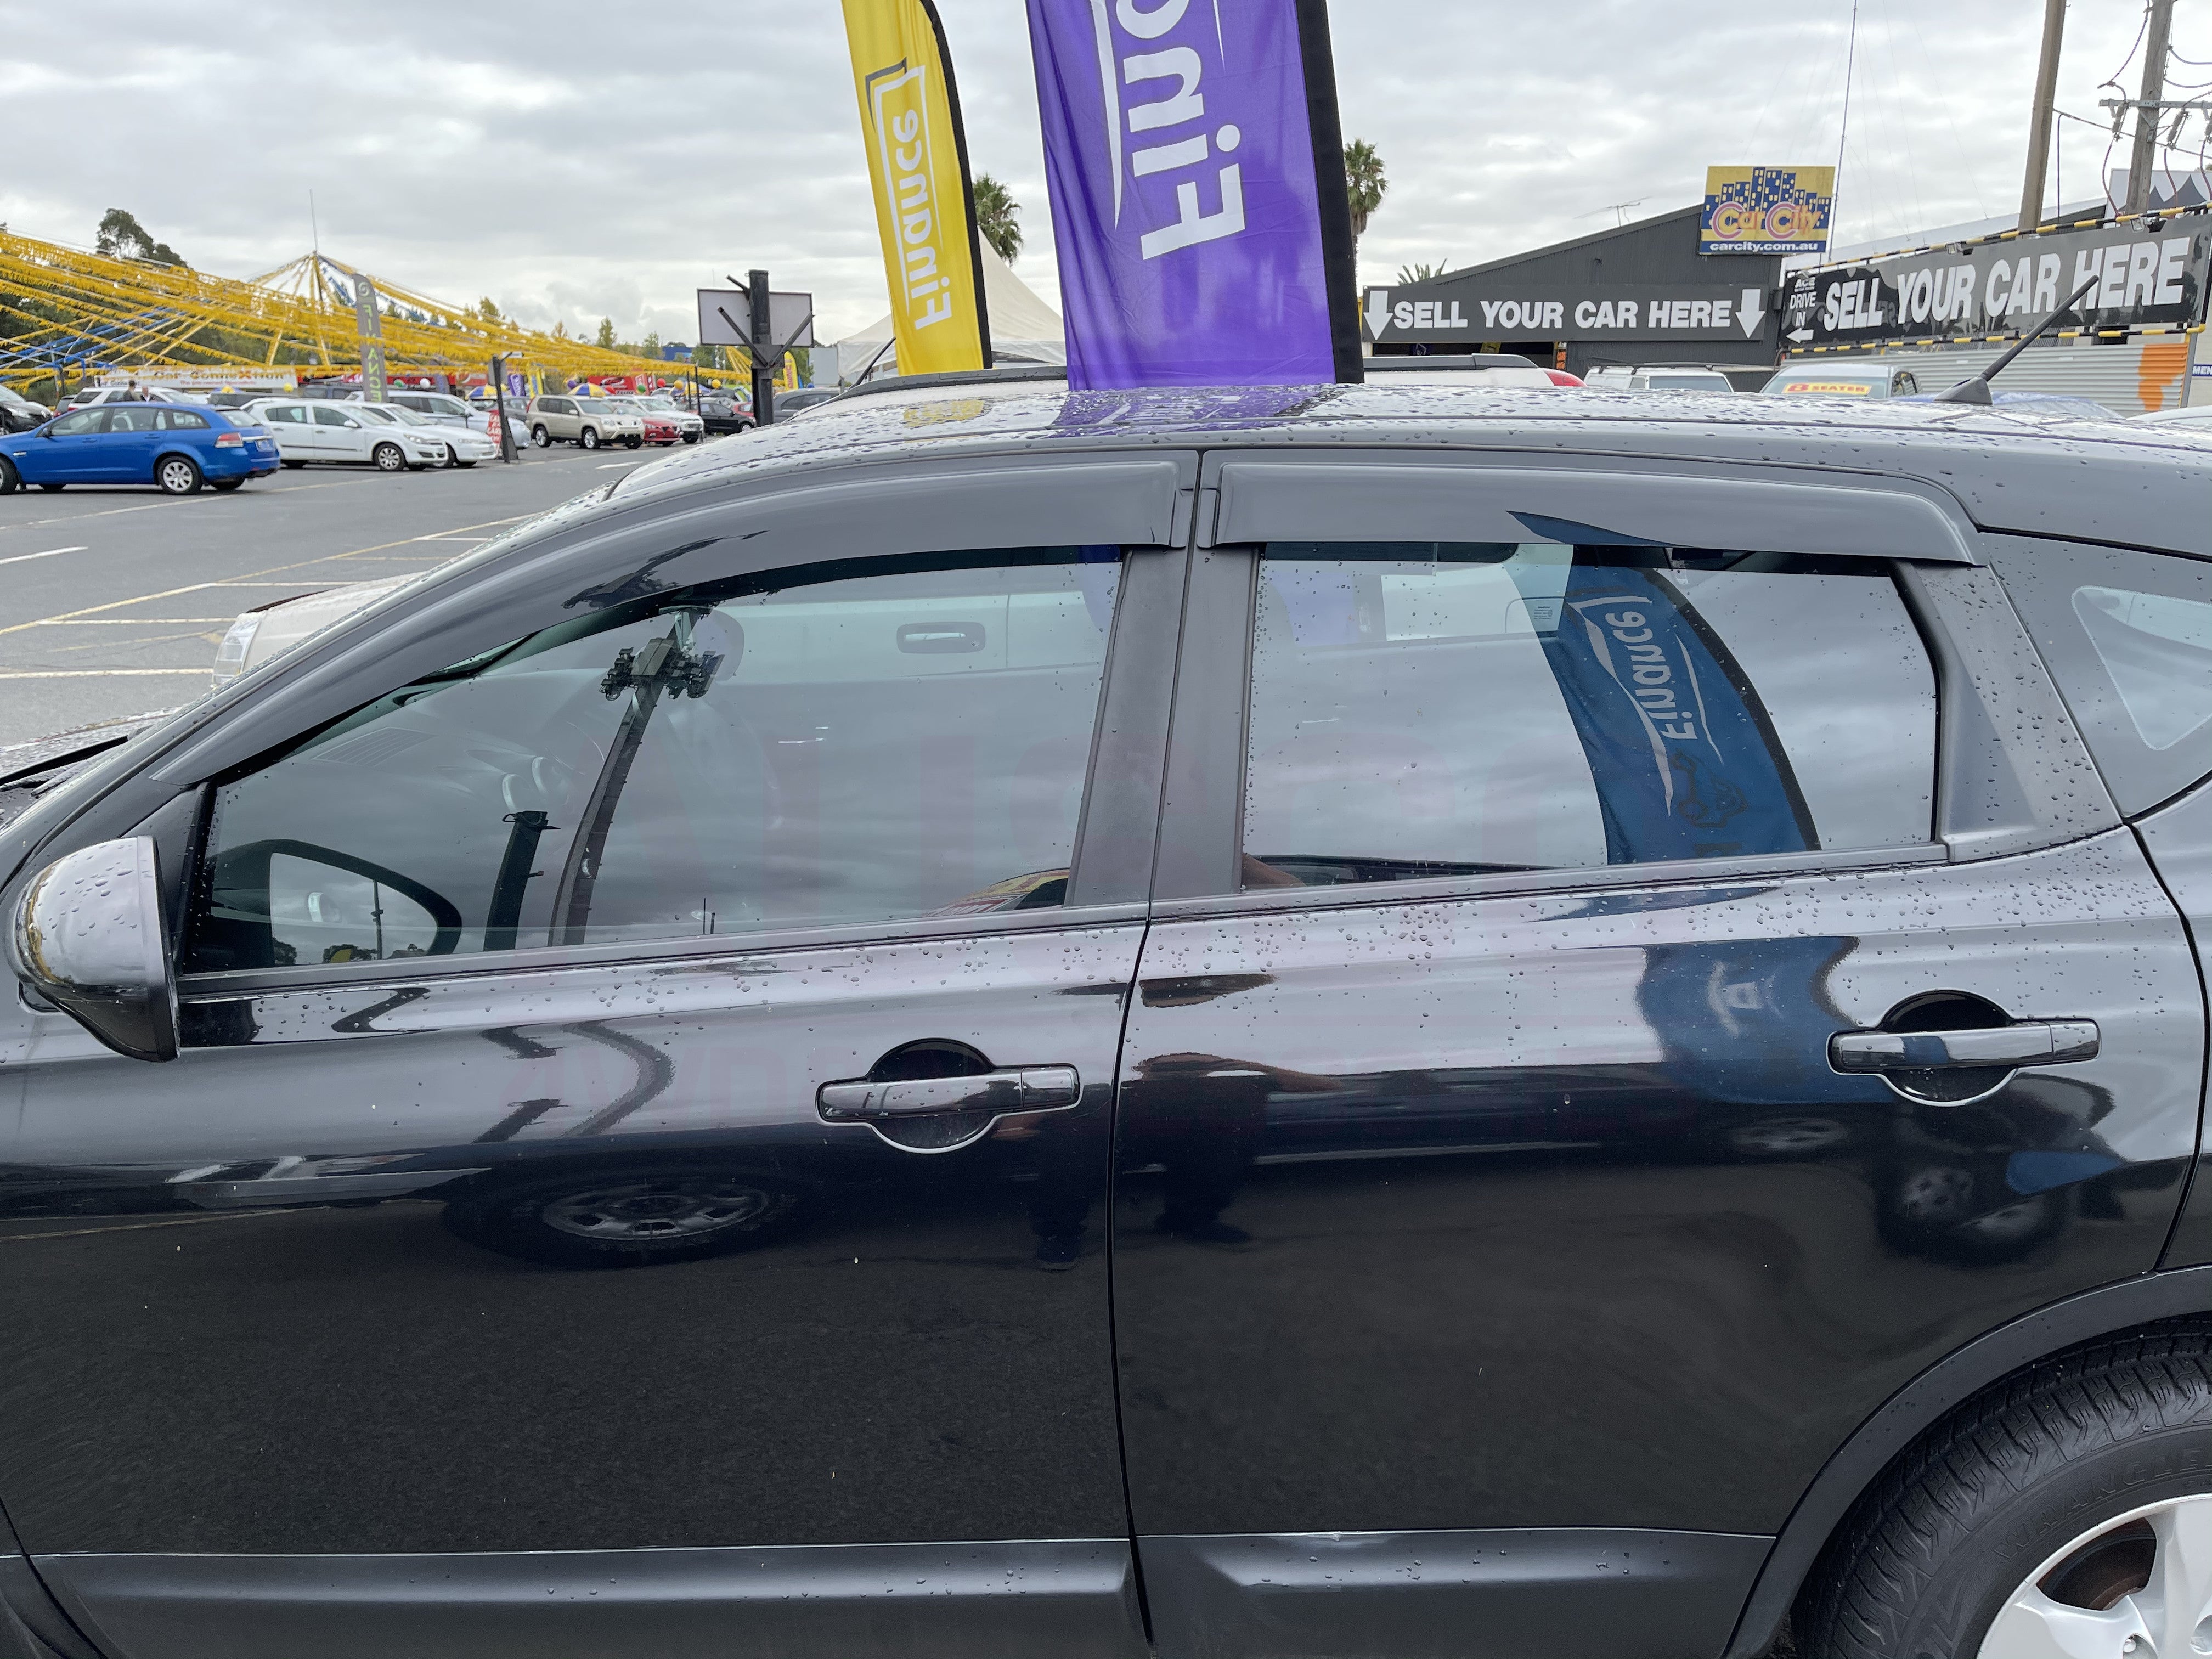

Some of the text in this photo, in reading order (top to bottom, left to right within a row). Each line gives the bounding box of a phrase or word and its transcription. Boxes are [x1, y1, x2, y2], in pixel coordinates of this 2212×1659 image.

[1709, 241, 1819, 253] carcity.com.au
[1824, 237, 2190, 331] SELL YOUR CAR HERE
[1790, 291, 1817, 309] DRIVE
[1393, 300, 1733, 329] SELL YOUR CAR HERE
[1795, 311, 1806, 326] IN
